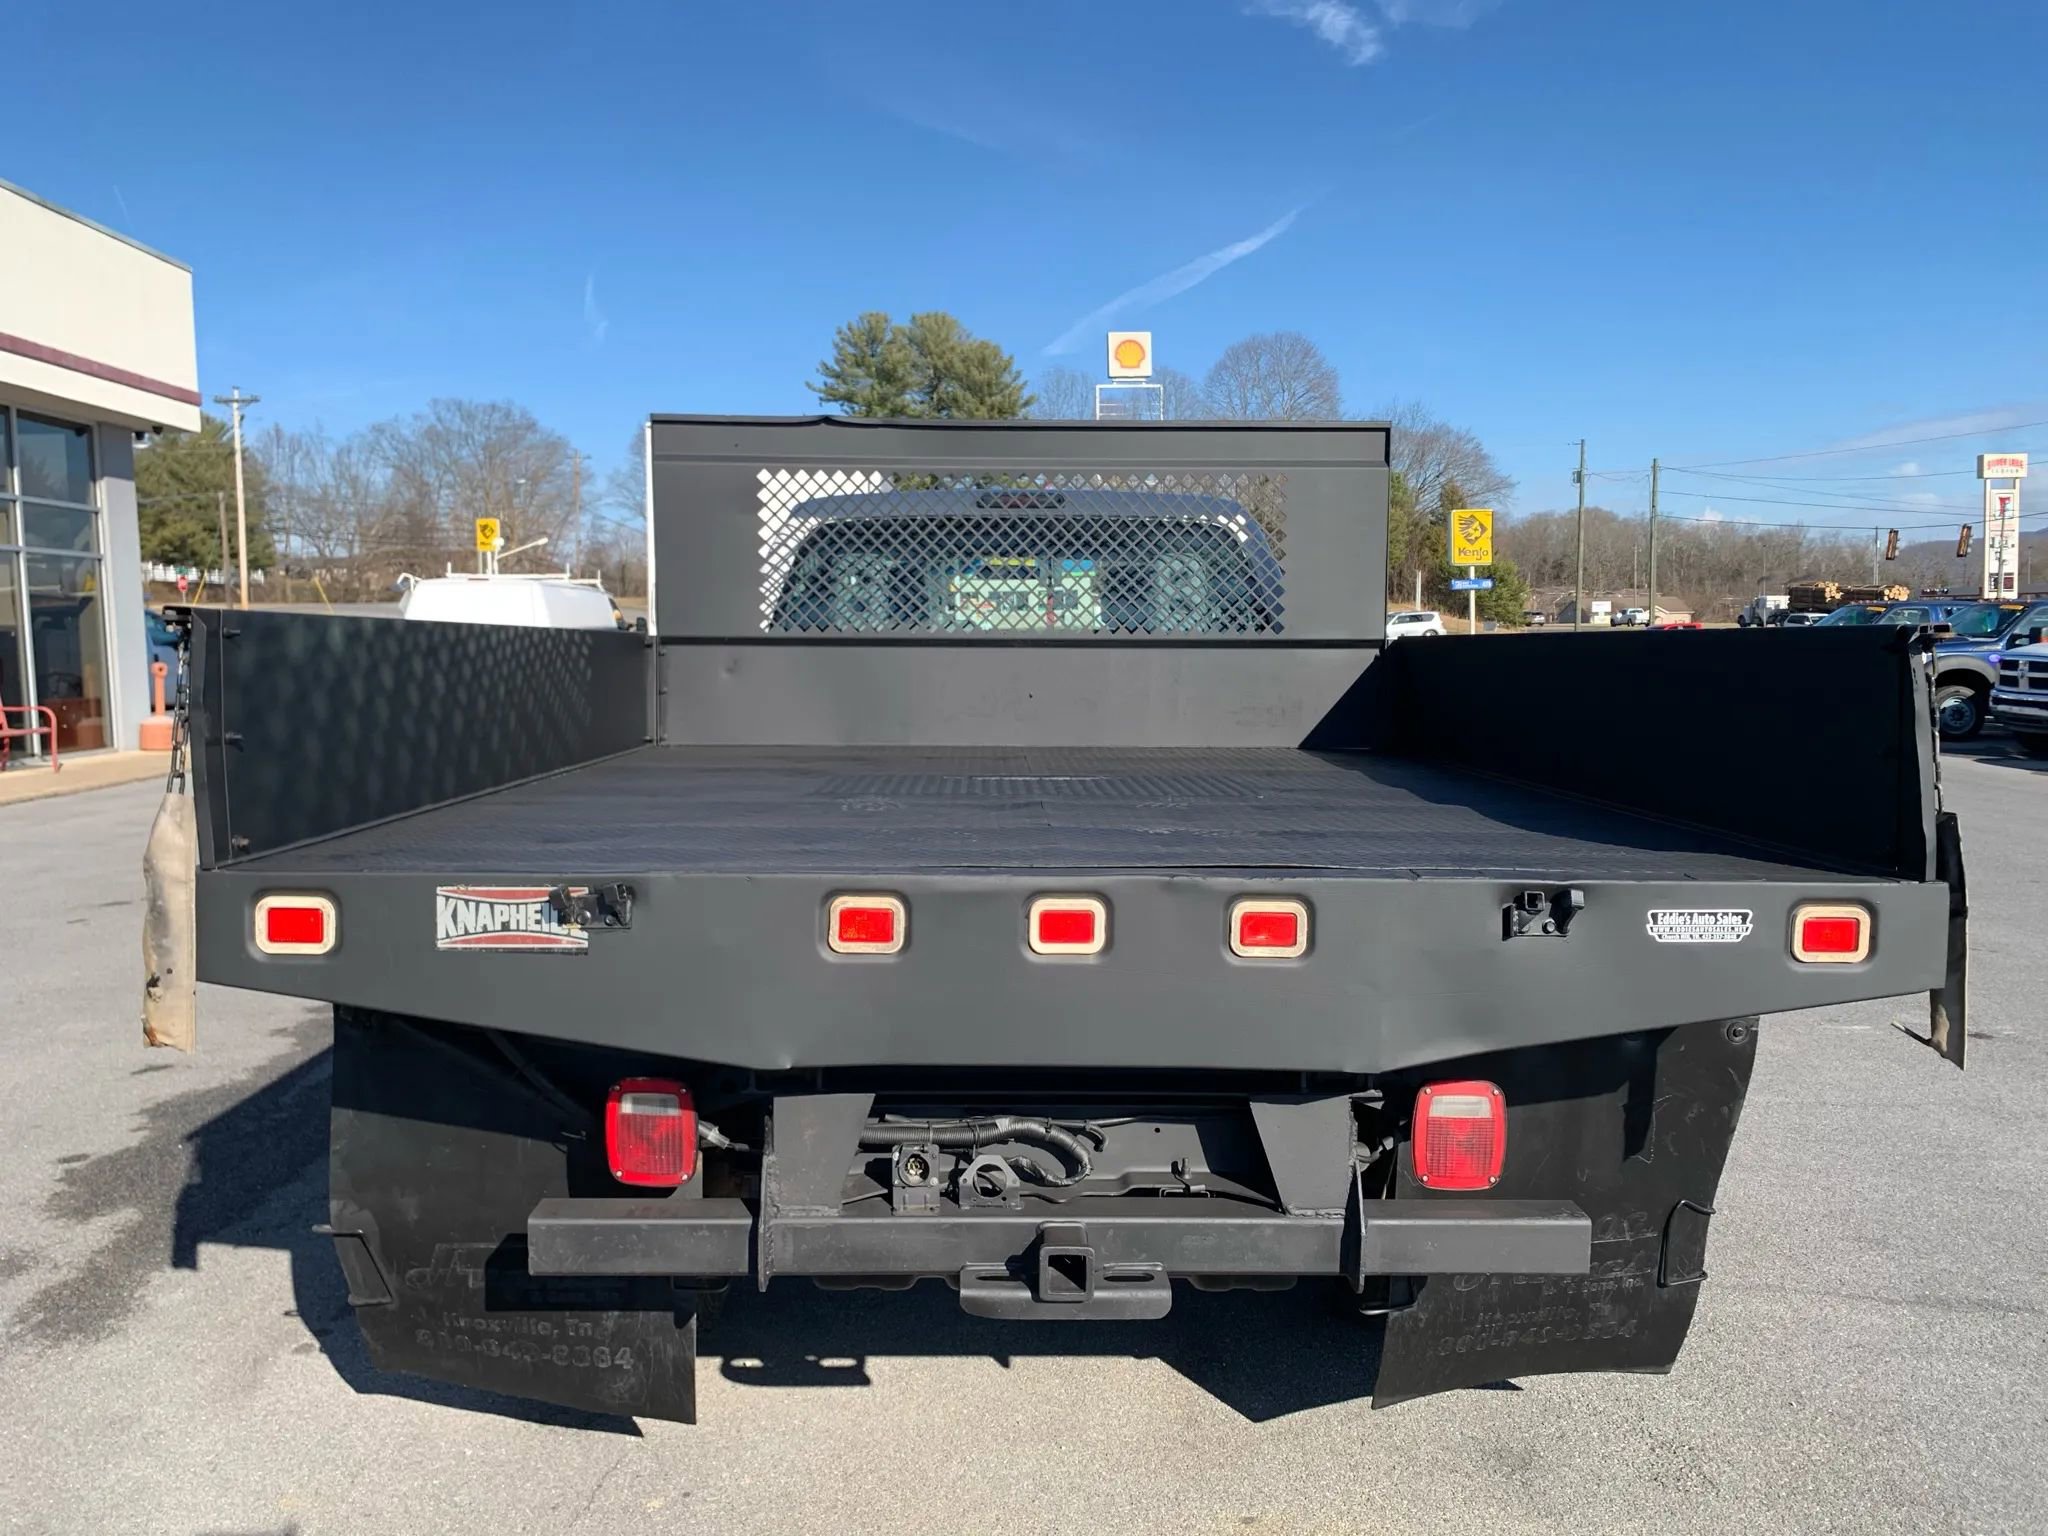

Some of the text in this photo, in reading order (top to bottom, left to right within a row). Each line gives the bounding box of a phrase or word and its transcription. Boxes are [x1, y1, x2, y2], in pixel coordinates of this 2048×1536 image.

[1458, 547, 1489, 560] Kenjo
[436, 895, 589, 940] KNAPHEI
[1657, 912, 1743, 925] Eddie's Auto Sales
